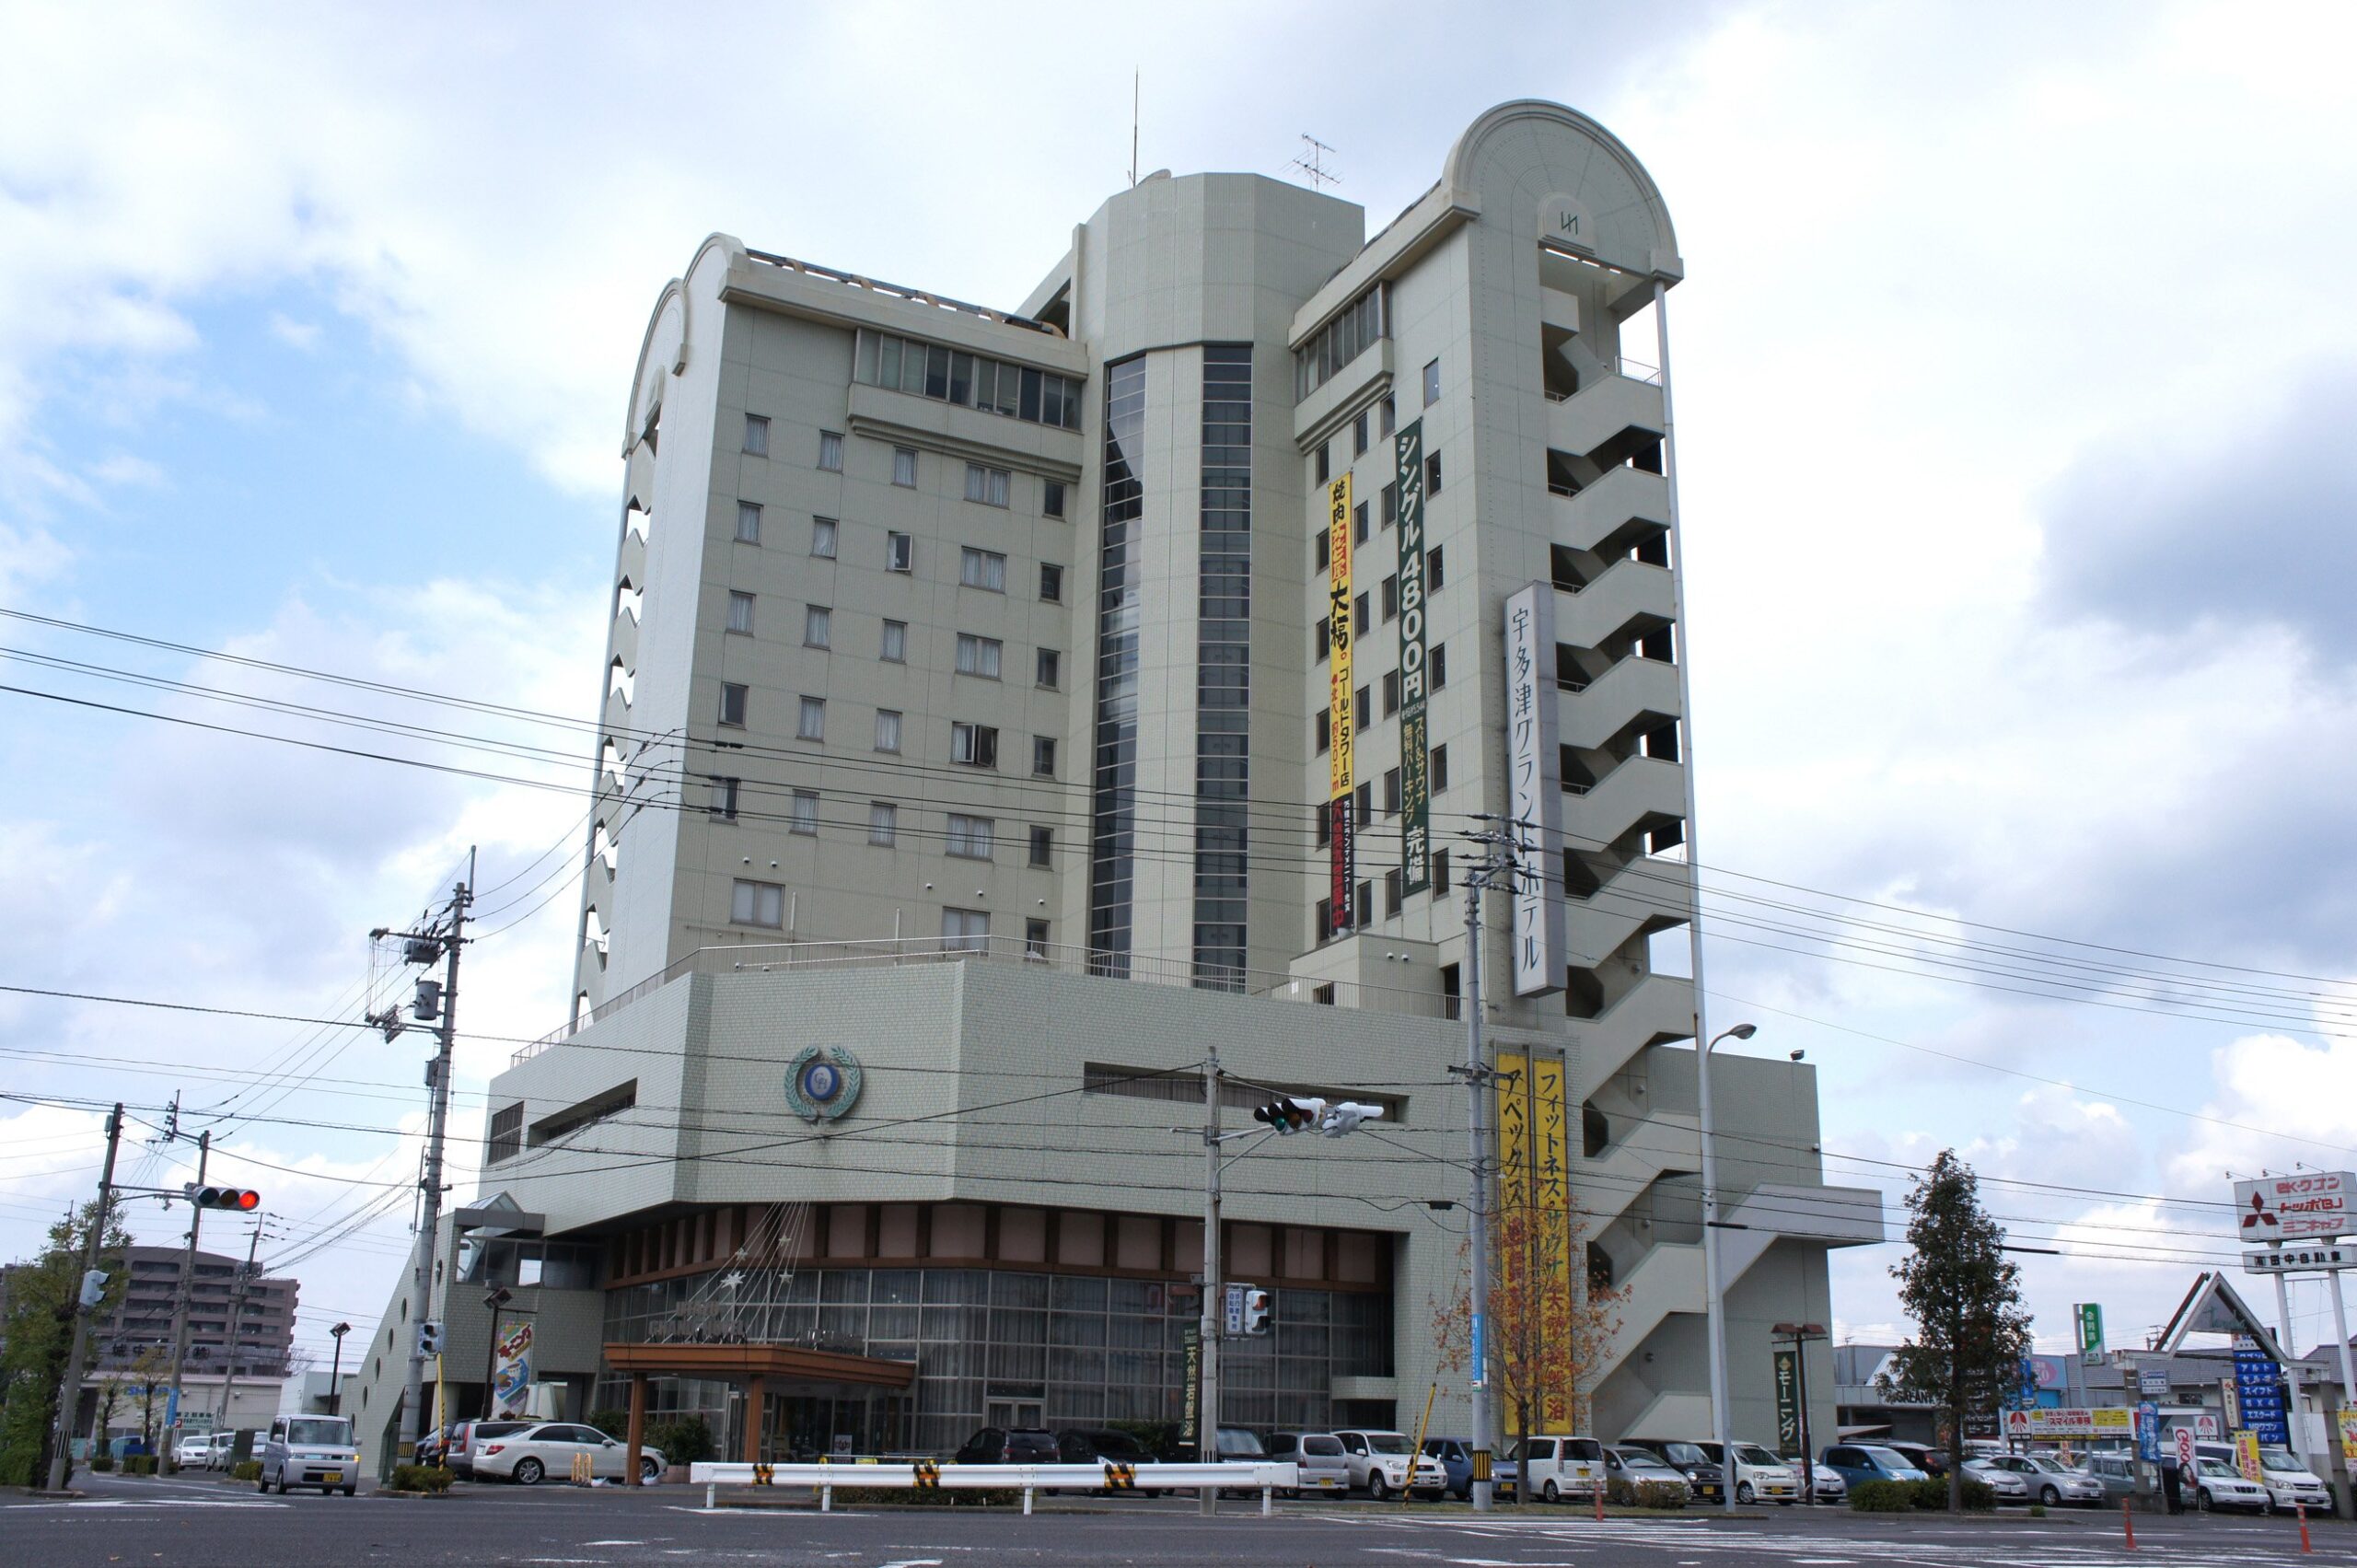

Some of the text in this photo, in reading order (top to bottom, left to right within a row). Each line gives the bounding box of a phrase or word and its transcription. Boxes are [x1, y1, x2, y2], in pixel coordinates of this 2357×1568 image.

[1399, 435, 1422, 704] シングル4800円
[1406, 825, 1425, 886] 完備
[1512, 607, 1541, 973] 宇多津グランドホテル
[1779, 1371, 1796, 1442] モーニング
